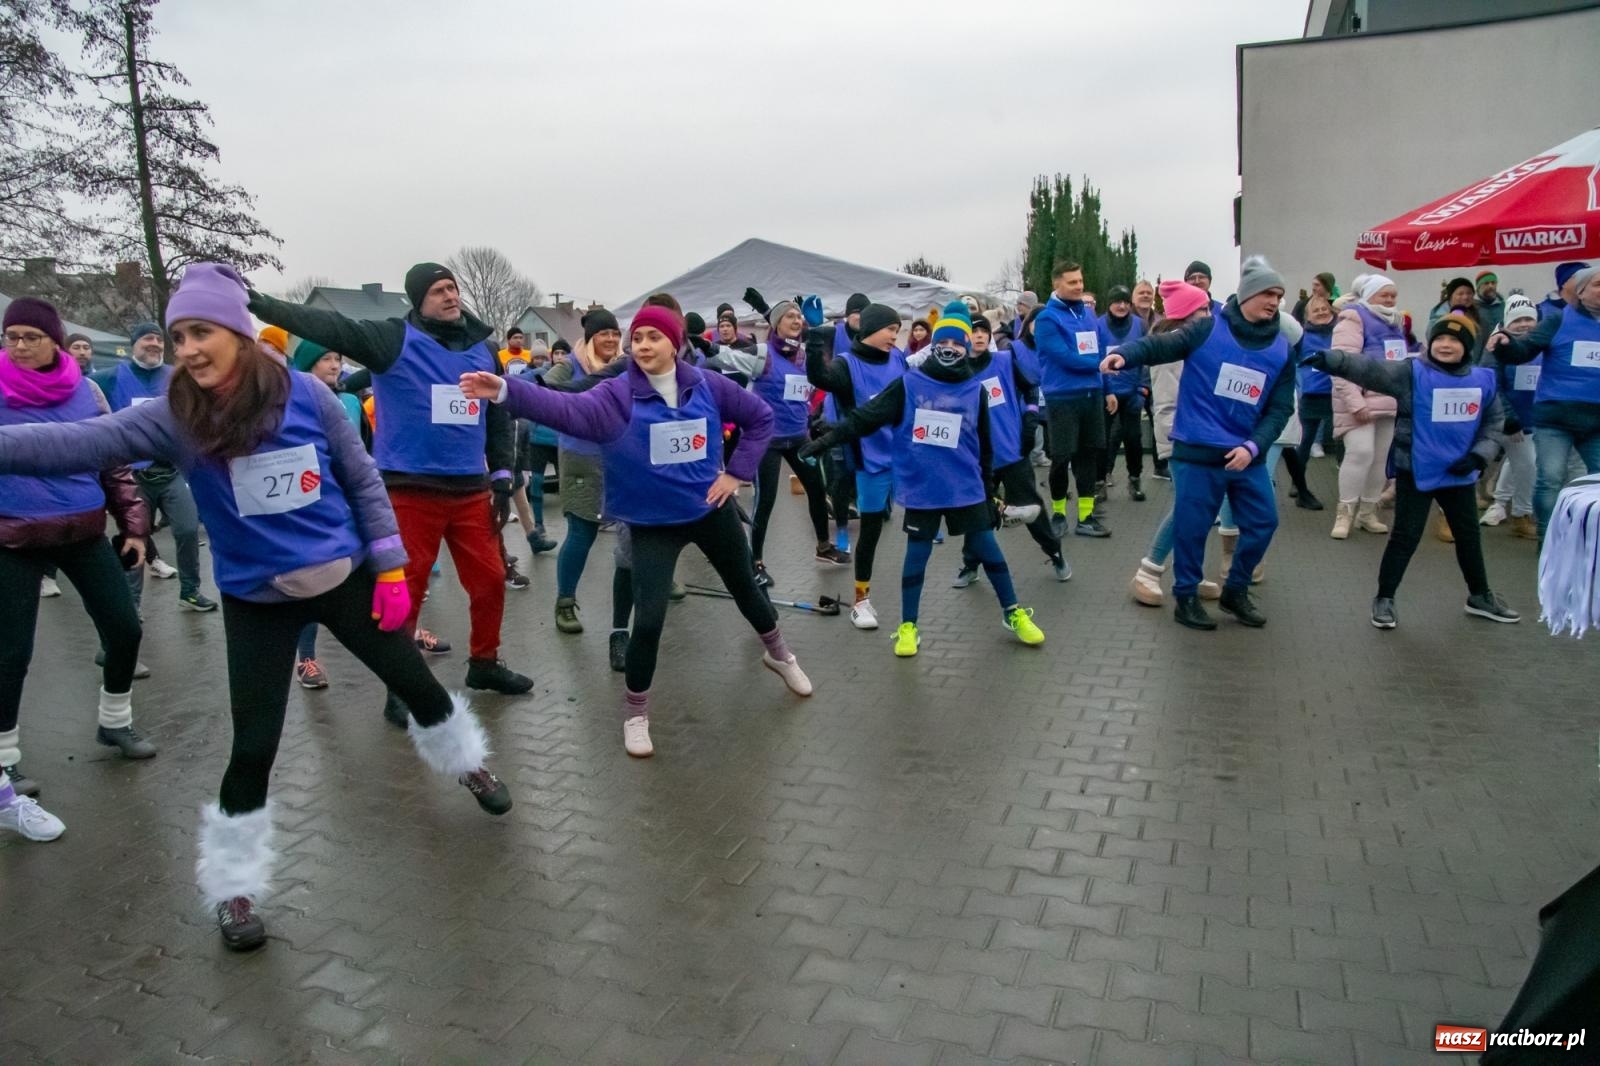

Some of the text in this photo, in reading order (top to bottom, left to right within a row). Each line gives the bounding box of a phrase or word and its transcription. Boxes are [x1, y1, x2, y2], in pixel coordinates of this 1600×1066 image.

[1423, 159, 1549, 220] WARKA
[1415, 231, 1459, 252] Classic
[1502, 229, 1578, 248] WARKA
[1227, 379, 1251, 396] 108
[449, 400, 467, 415] 65
[1444, 402, 1468, 416] 110
[925, 425, 950, 440] 146
[669, 436, 691, 454] 33
[263, 472, 295, 498] 27
